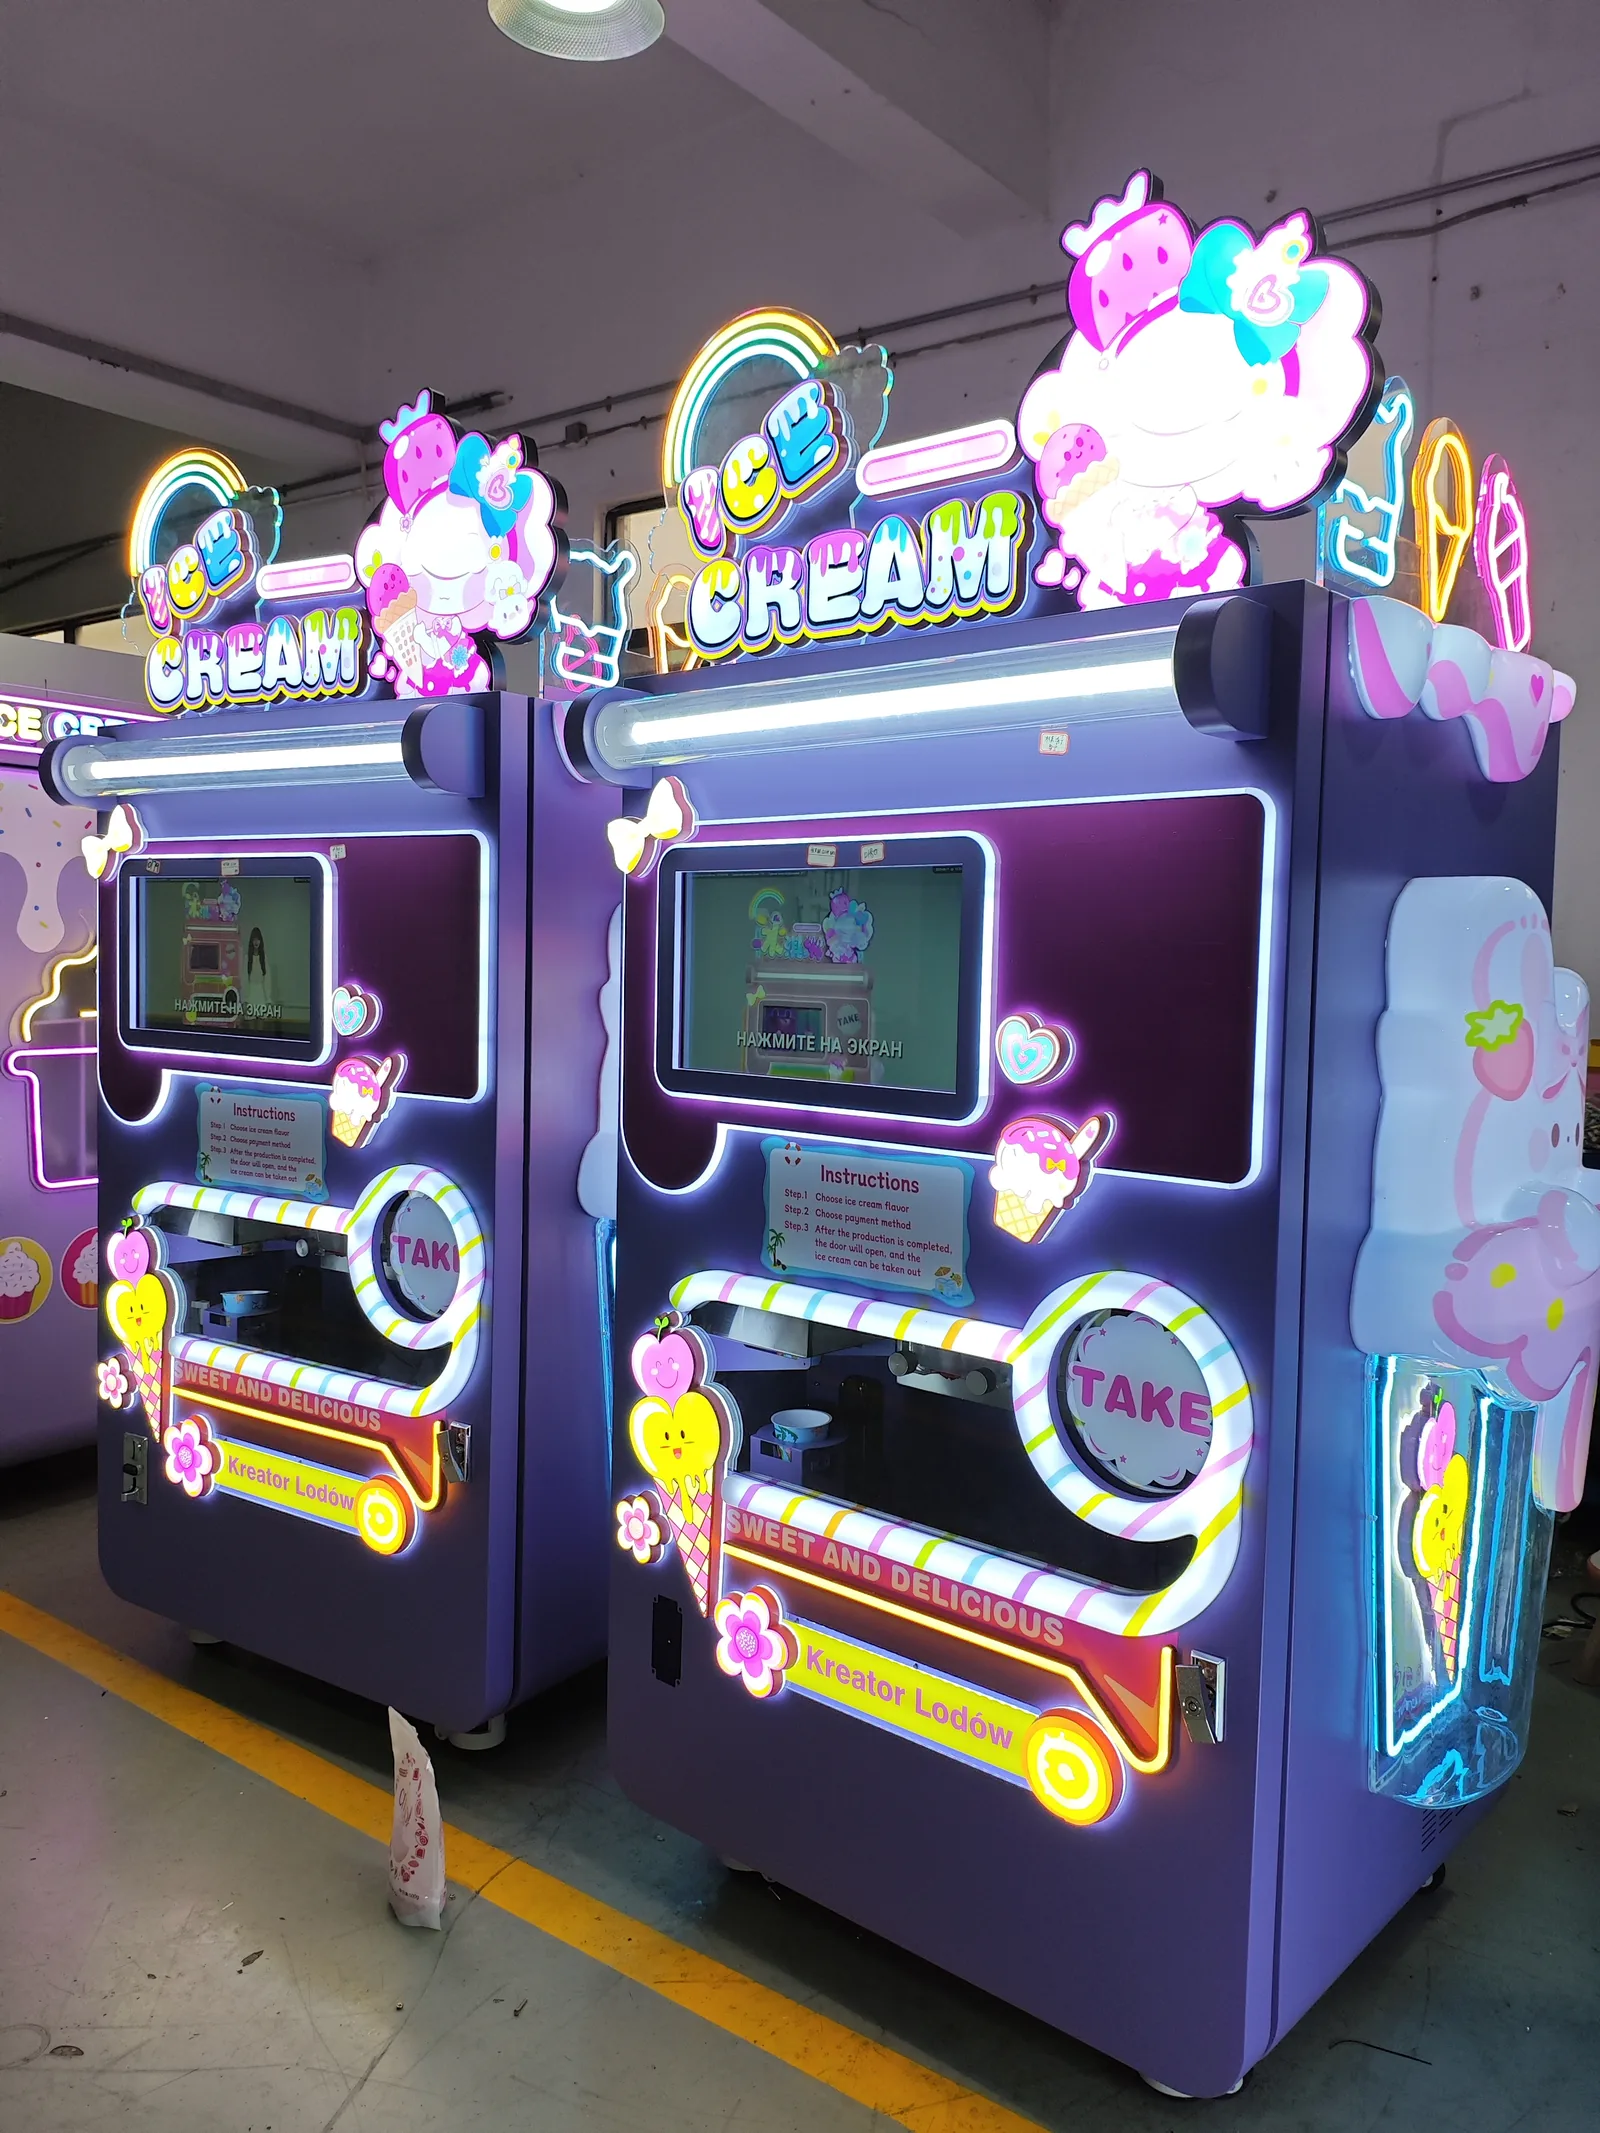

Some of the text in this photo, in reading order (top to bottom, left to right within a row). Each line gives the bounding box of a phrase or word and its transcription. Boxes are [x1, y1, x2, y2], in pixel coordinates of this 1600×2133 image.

[678, 379, 840, 562] ICE
[685, 490, 1026, 660] CREAM
[145, 607, 363, 713] CREAM
[174, 999, 281, 1017] НАЖМИТЕ НА ЭКРАН
[837, 1014, 860, 1026] TAKE
[736, 1031, 903, 1058] НАЖМИТЕ НА ЭКРАН
[233, 1103, 295, 1121] Instructions
[230, 1124, 247, 1132] Choose
[274, 1128, 289, 1136] flavor
[230, 1136, 247, 1144] Choose
[249, 1139, 270, 1148] payment
[254, 1151, 281, 1161] production
[821, 1165, 919, 1193] Instructions
[785, 1189, 909, 1213] Step.1 Choose ice cream flavor
[785, 1205, 911, 1230] Step.2 Choose payment method
[785, 1221, 952, 1254] Step.3 After the production is completed,
[815, 1238, 920, 1262] the door will open, and the
[815, 1251, 921, 1276] ice cream can be taken out
[174, 1360, 381, 1431] SWEET AND DELICIOUS
[1073, 1365, 1211, 1437] TAKE
[228, 1456, 354, 1510] Kreator Lodów
[727, 1510, 1064, 1646] SWEET AND DELICIOUS
[807, 1645, 1013, 1749] Kreator Lodów
